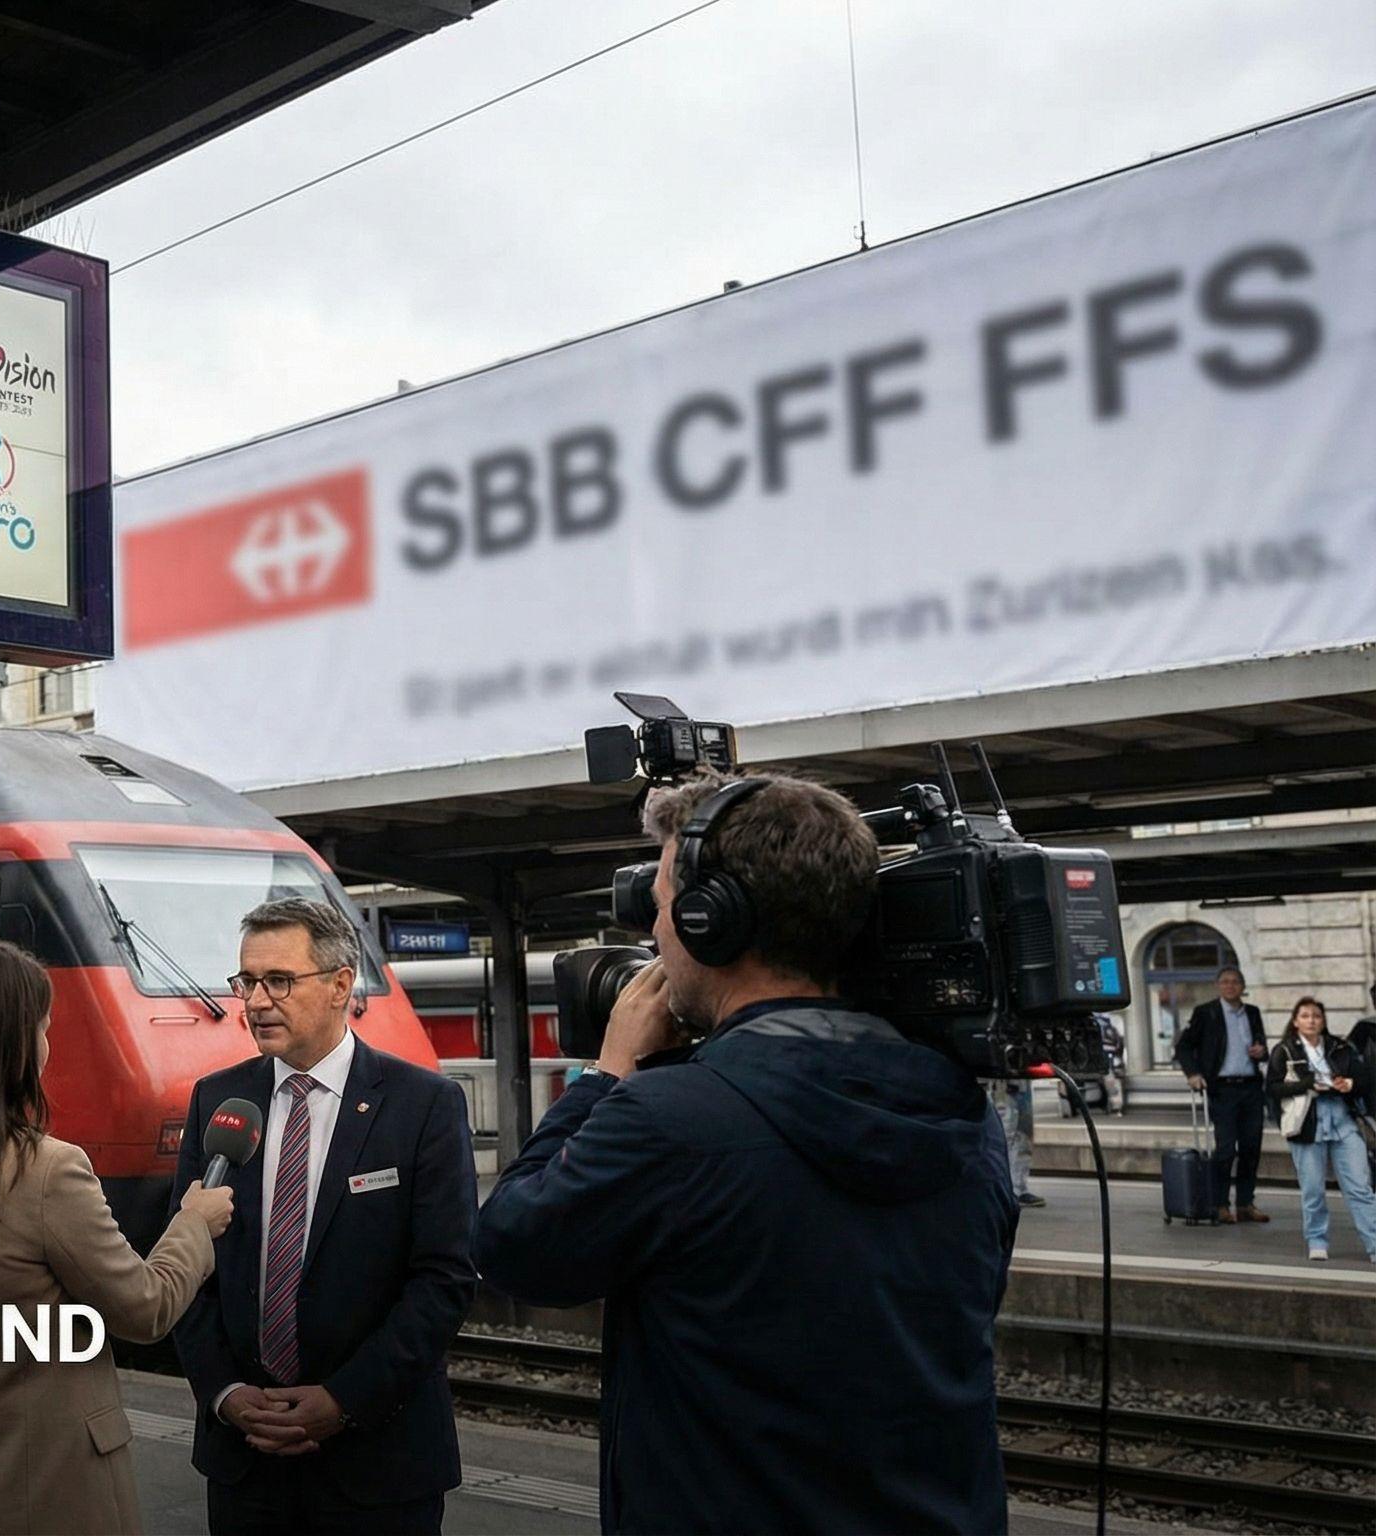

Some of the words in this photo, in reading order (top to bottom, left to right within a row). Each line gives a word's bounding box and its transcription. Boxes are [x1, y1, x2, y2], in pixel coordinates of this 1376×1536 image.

[400, 426, 624, 574] SBB
[652, 337, 928, 512] CFF
[978, 239, 1329, 445] FFS
